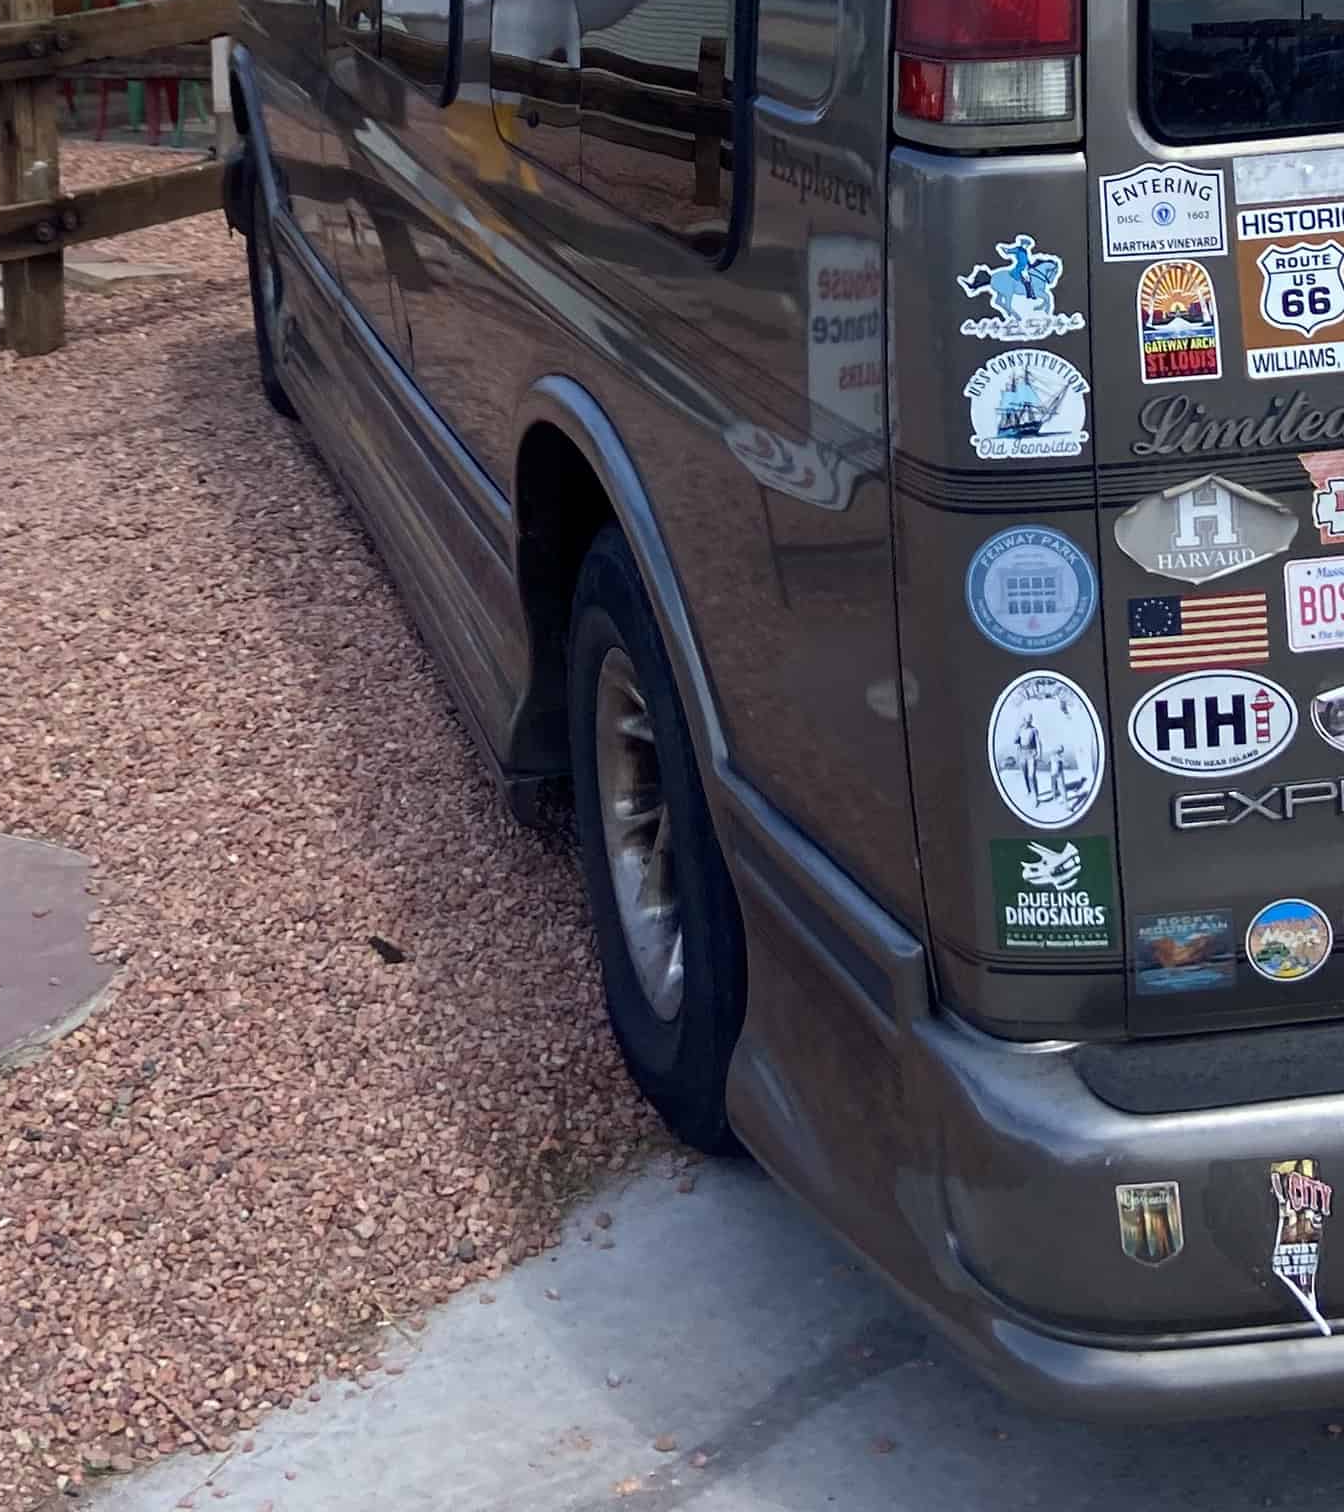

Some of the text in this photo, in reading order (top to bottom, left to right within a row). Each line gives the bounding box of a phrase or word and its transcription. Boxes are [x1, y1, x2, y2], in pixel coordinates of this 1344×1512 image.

[769, 138, 872, 216] Explorer
[1111, 176, 1214, 207] ENTERING
[1111, 234, 1219, 253] MARTHA'S VINEYARD
[1274, 252, 1333, 270] ROUTE
[1292, 271, 1317, 287] US
[1281, 287, 1333, 318] 66
[1143, 335, 1217, 356] GATEWAY ARCH
[1168, 348, 1218, 371] LOUIS
[1251, 346, 1343, 375] WILLIAMS,
[967, 351, 1088, 398] USS CONSTITUTION
[1174, 486, 1239, 548] H
[980, 532, 1080, 568] FENWAY PARK
[1157, 547, 1258, 570] HARVARD
[1227, 748, 1262, 766] ISLAND
[1017, 890, 1091, 907] DUELING
[1005, 905, 1106, 927] DINOSAURS
[1157, 913, 1216, 927] ROCKY
[1138, 921, 1229, 938] MOUNTAIN
[1287, 1171, 1333, 1217] CITY
